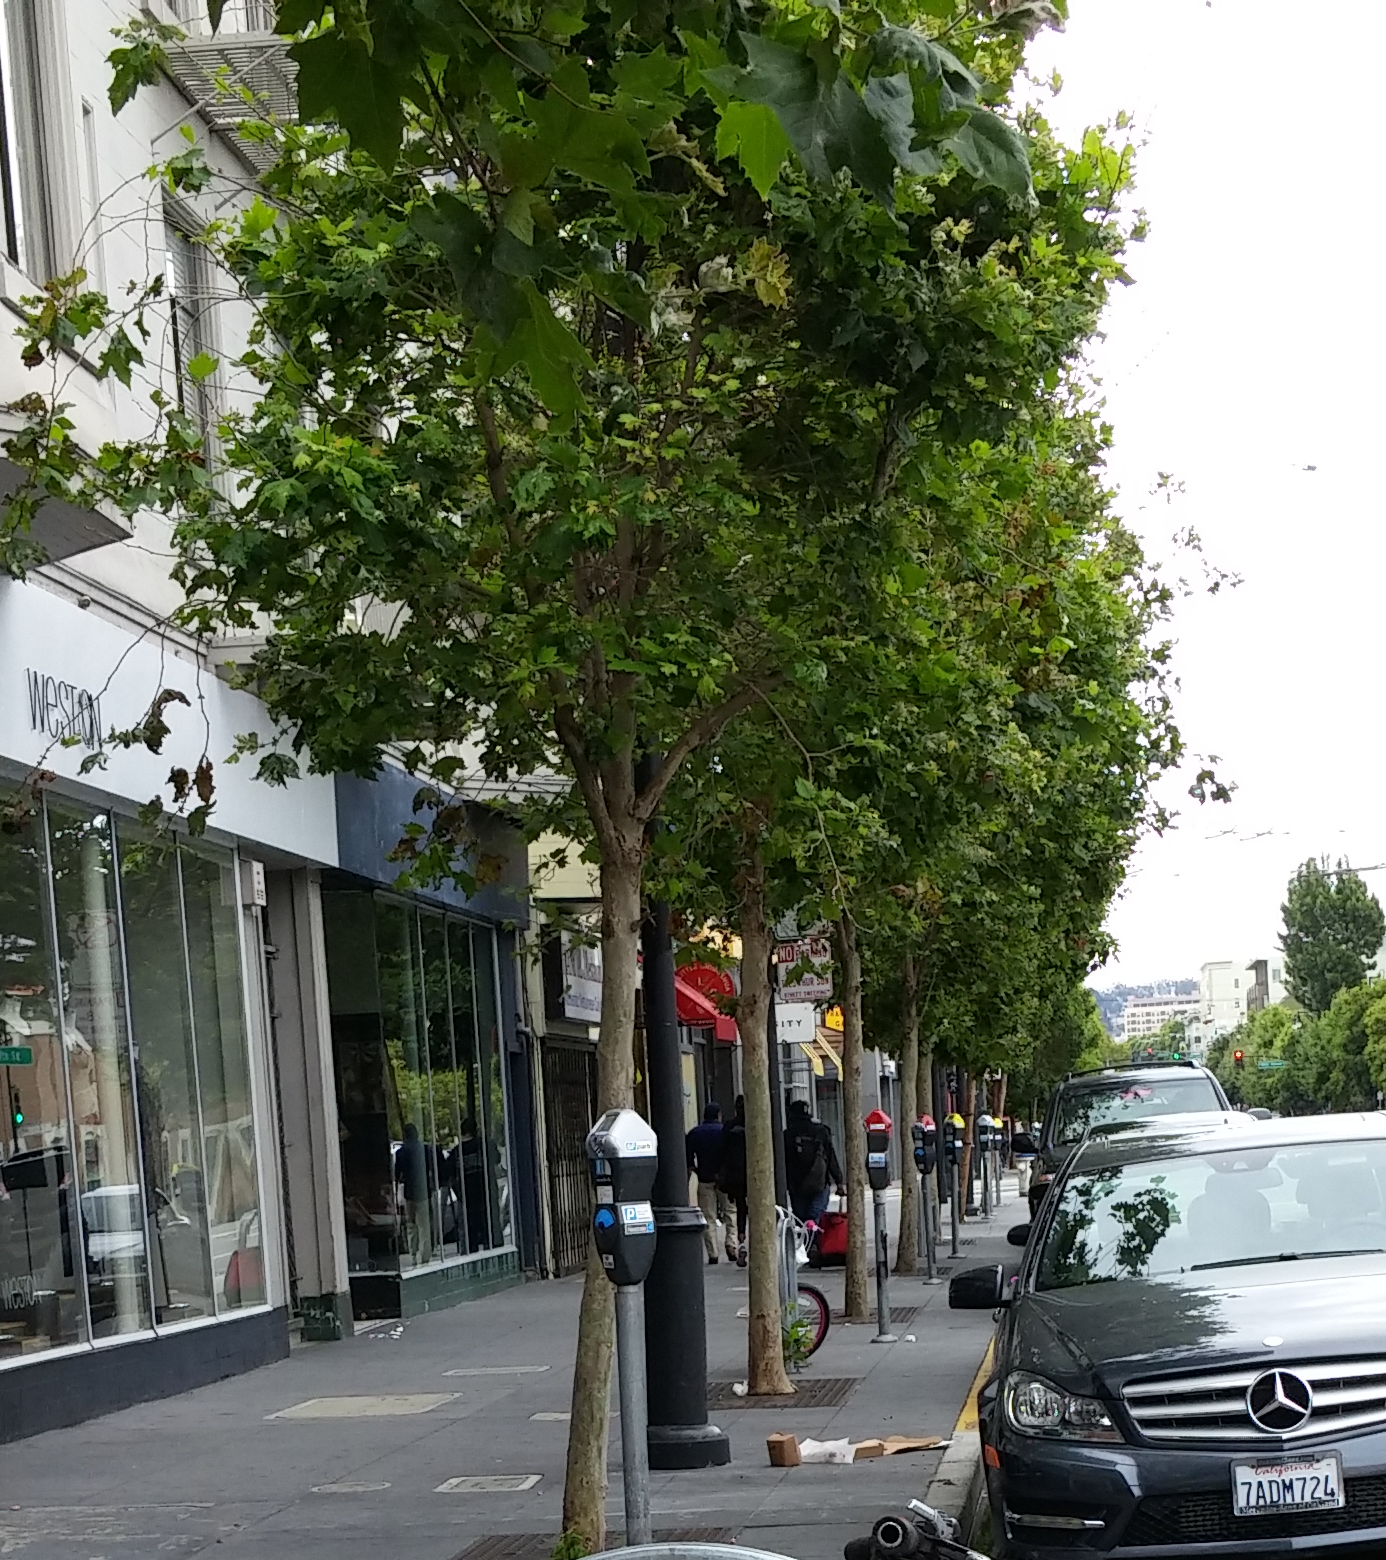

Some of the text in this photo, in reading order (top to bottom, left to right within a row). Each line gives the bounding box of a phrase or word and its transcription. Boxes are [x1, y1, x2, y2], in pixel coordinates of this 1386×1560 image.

[780, 946, 793, 962] NO
[776, 1019, 802, 1028] ITY
[1240, 1475, 1336, 1507] 7ADM724
